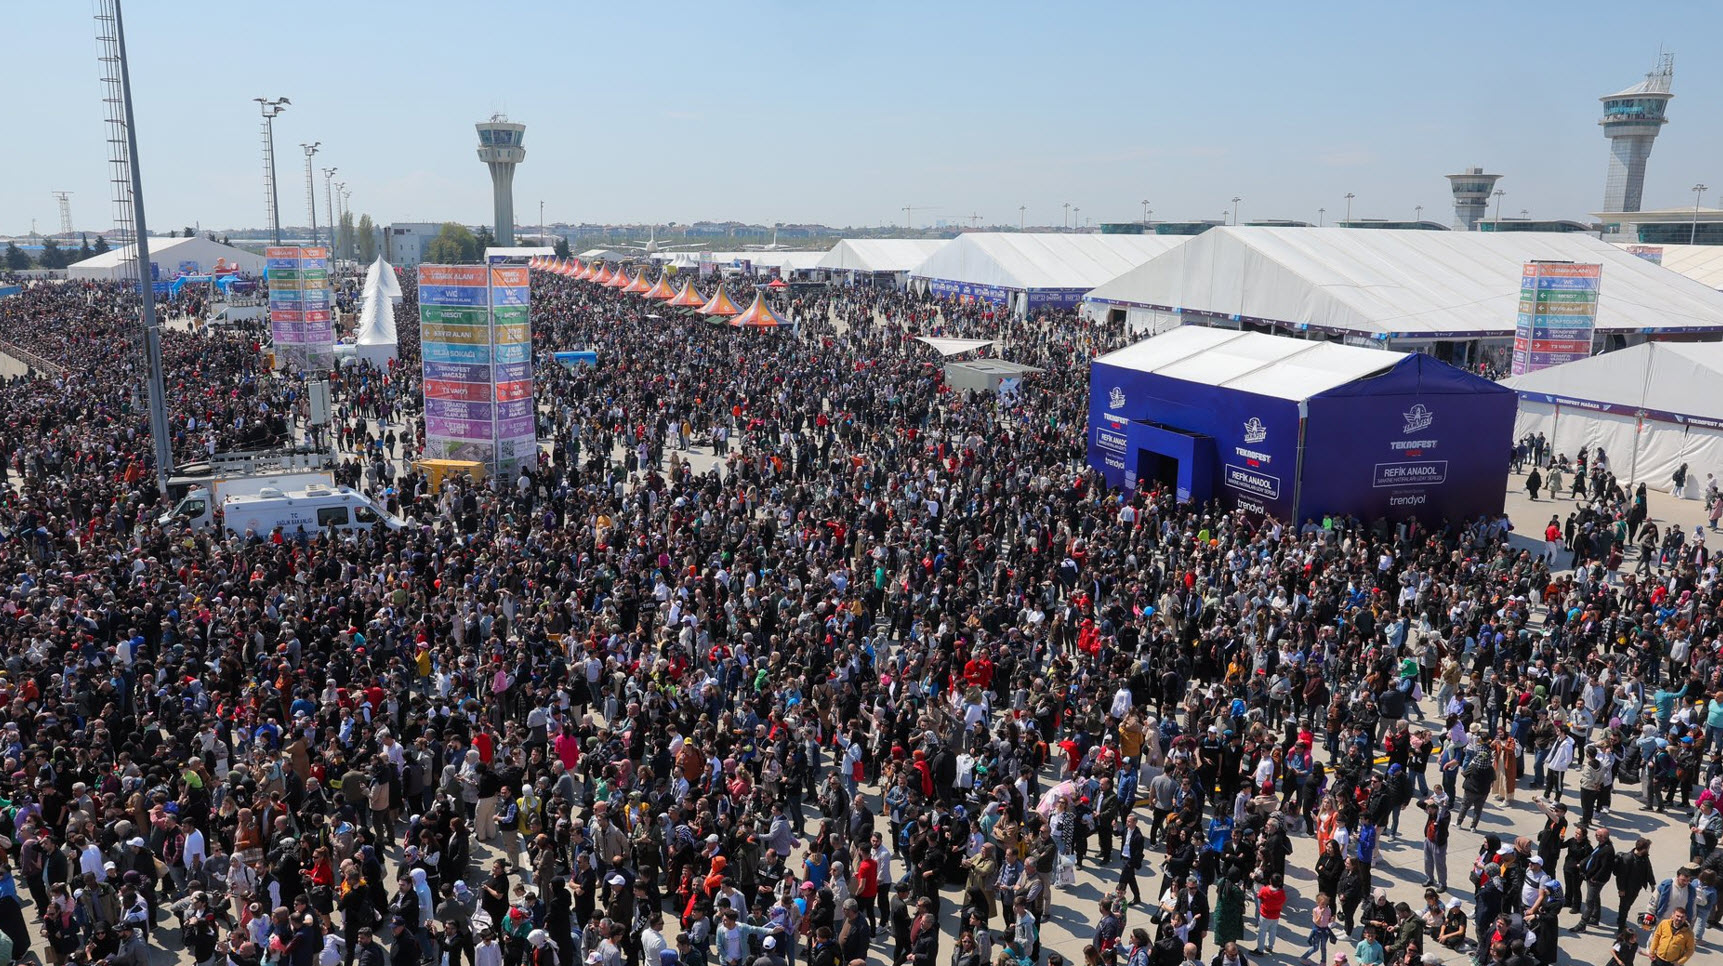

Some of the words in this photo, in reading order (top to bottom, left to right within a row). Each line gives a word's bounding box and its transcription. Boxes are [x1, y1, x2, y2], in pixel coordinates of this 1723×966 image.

[1688, 418, 1717, 426] TEKNOFEST
[1390, 440, 1437, 449] TEKNOFEST
[1235, 447, 1271, 463] TEKNOFEST
[1105, 457, 1125, 470] trendyol
[1384, 467, 1406, 477] REFİK
[1407, 467, 1437, 475] ANADOL
[1249, 475, 1272, 489] ANADOL
[1390, 495, 1425, 506] trendyol
[1237, 499, 1264, 515] trendyol
